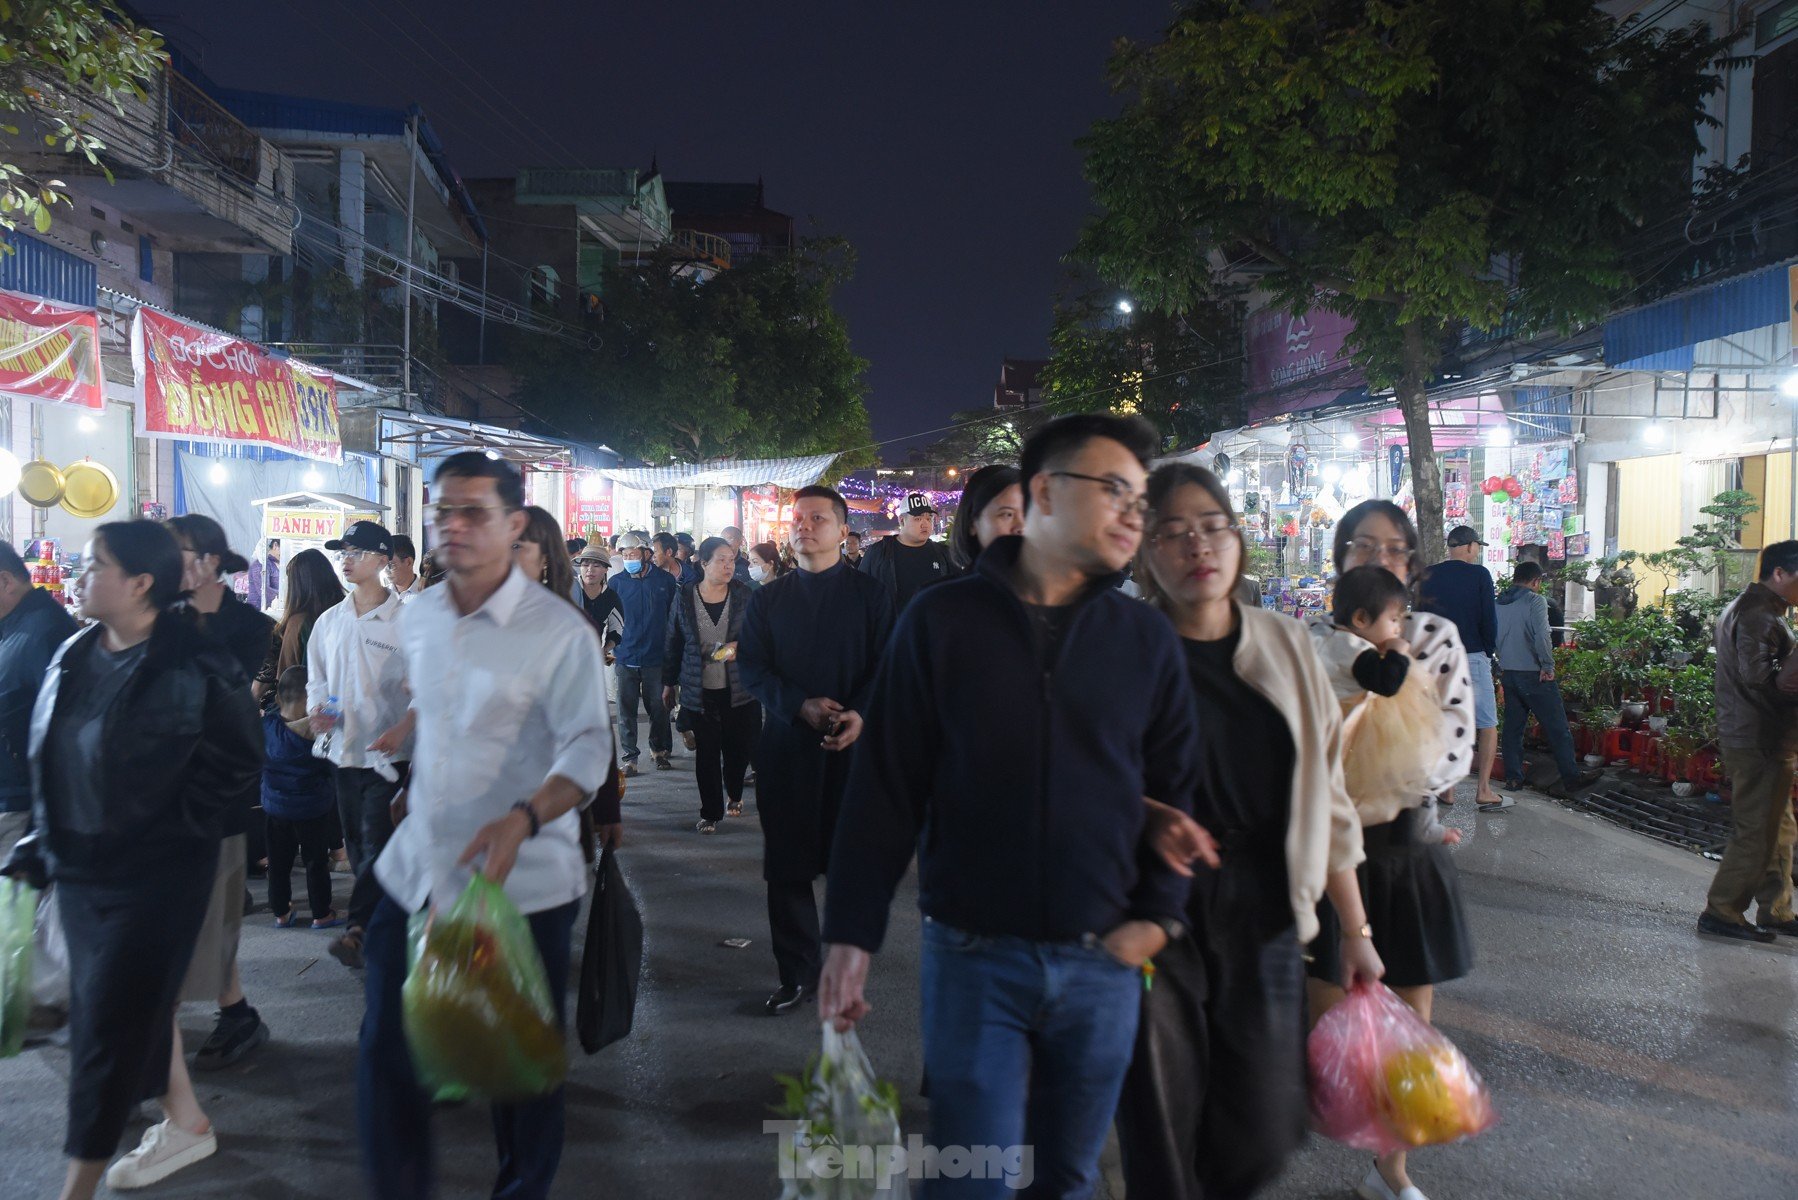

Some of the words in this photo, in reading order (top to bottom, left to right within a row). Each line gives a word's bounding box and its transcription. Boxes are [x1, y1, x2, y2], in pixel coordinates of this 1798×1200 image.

[166, 367, 260, 434] ĐỒNG
[296, 381, 336, 436] 39K
[272, 513, 311, 534] BÁNH
